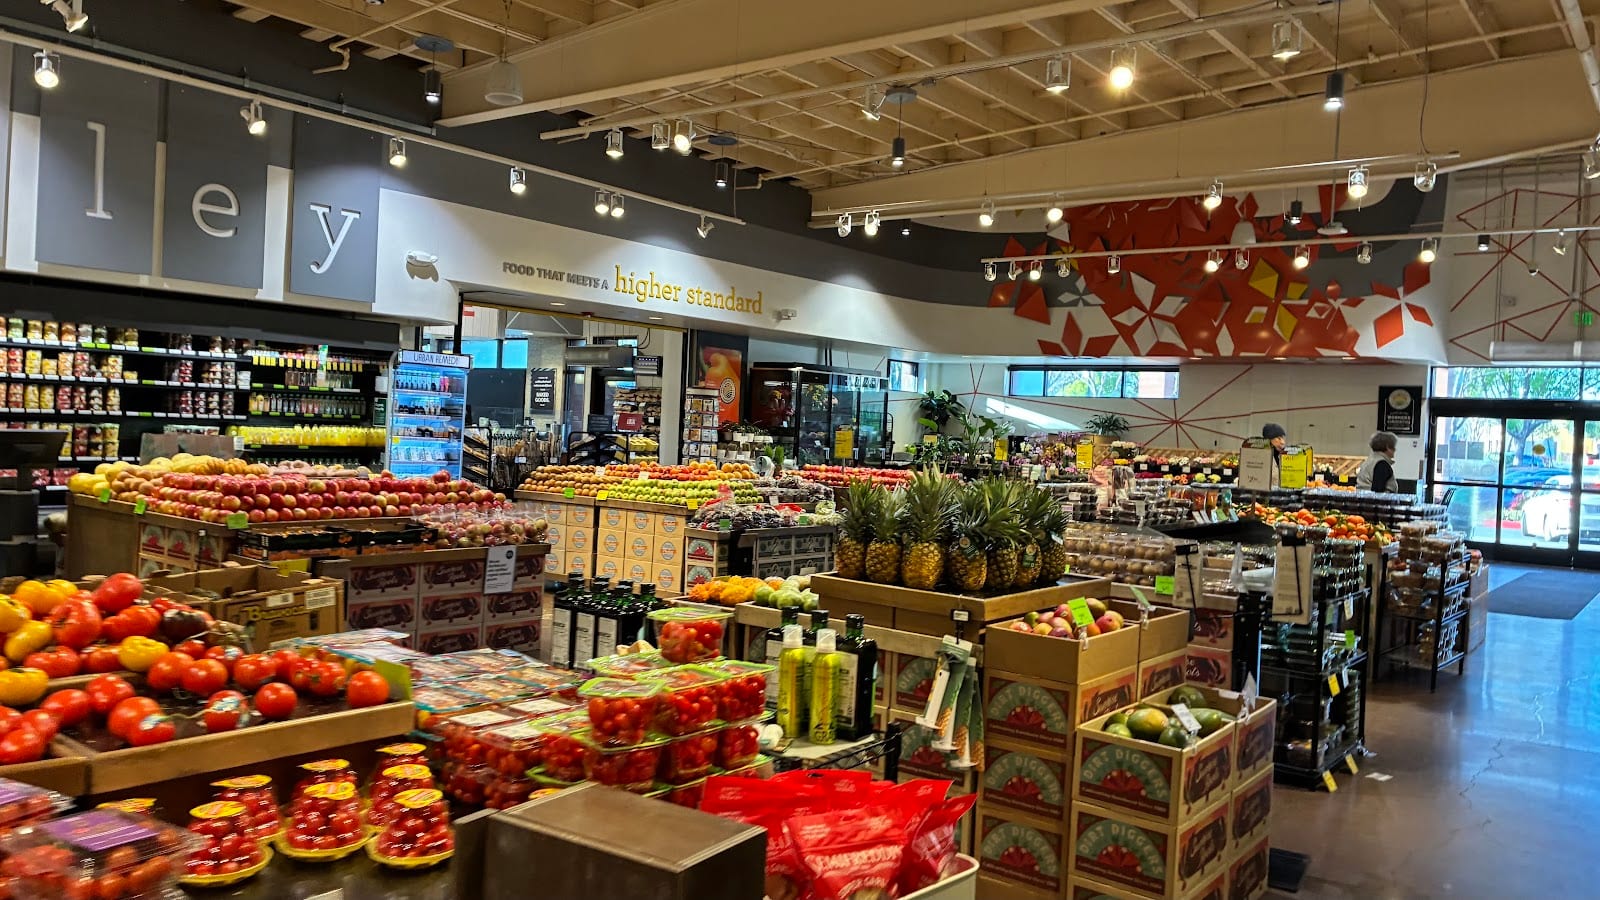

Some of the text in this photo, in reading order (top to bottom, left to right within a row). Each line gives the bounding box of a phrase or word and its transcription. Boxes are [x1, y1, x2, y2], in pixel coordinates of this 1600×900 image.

[502, 261, 763, 314] FOOD THAT MEETS A higher standard
[413, 352, 434, 362] URBAN
[990, 687, 1013, 717] DIRT
[1018, 686, 1066, 731] DIGGERS
[1083, 750, 1110, 780] DIRT
[1115, 748, 1169, 799] DIGGERS
[1080, 824, 1105, 854] DIRT
[1111, 823, 1163, 875] DIGGERS
